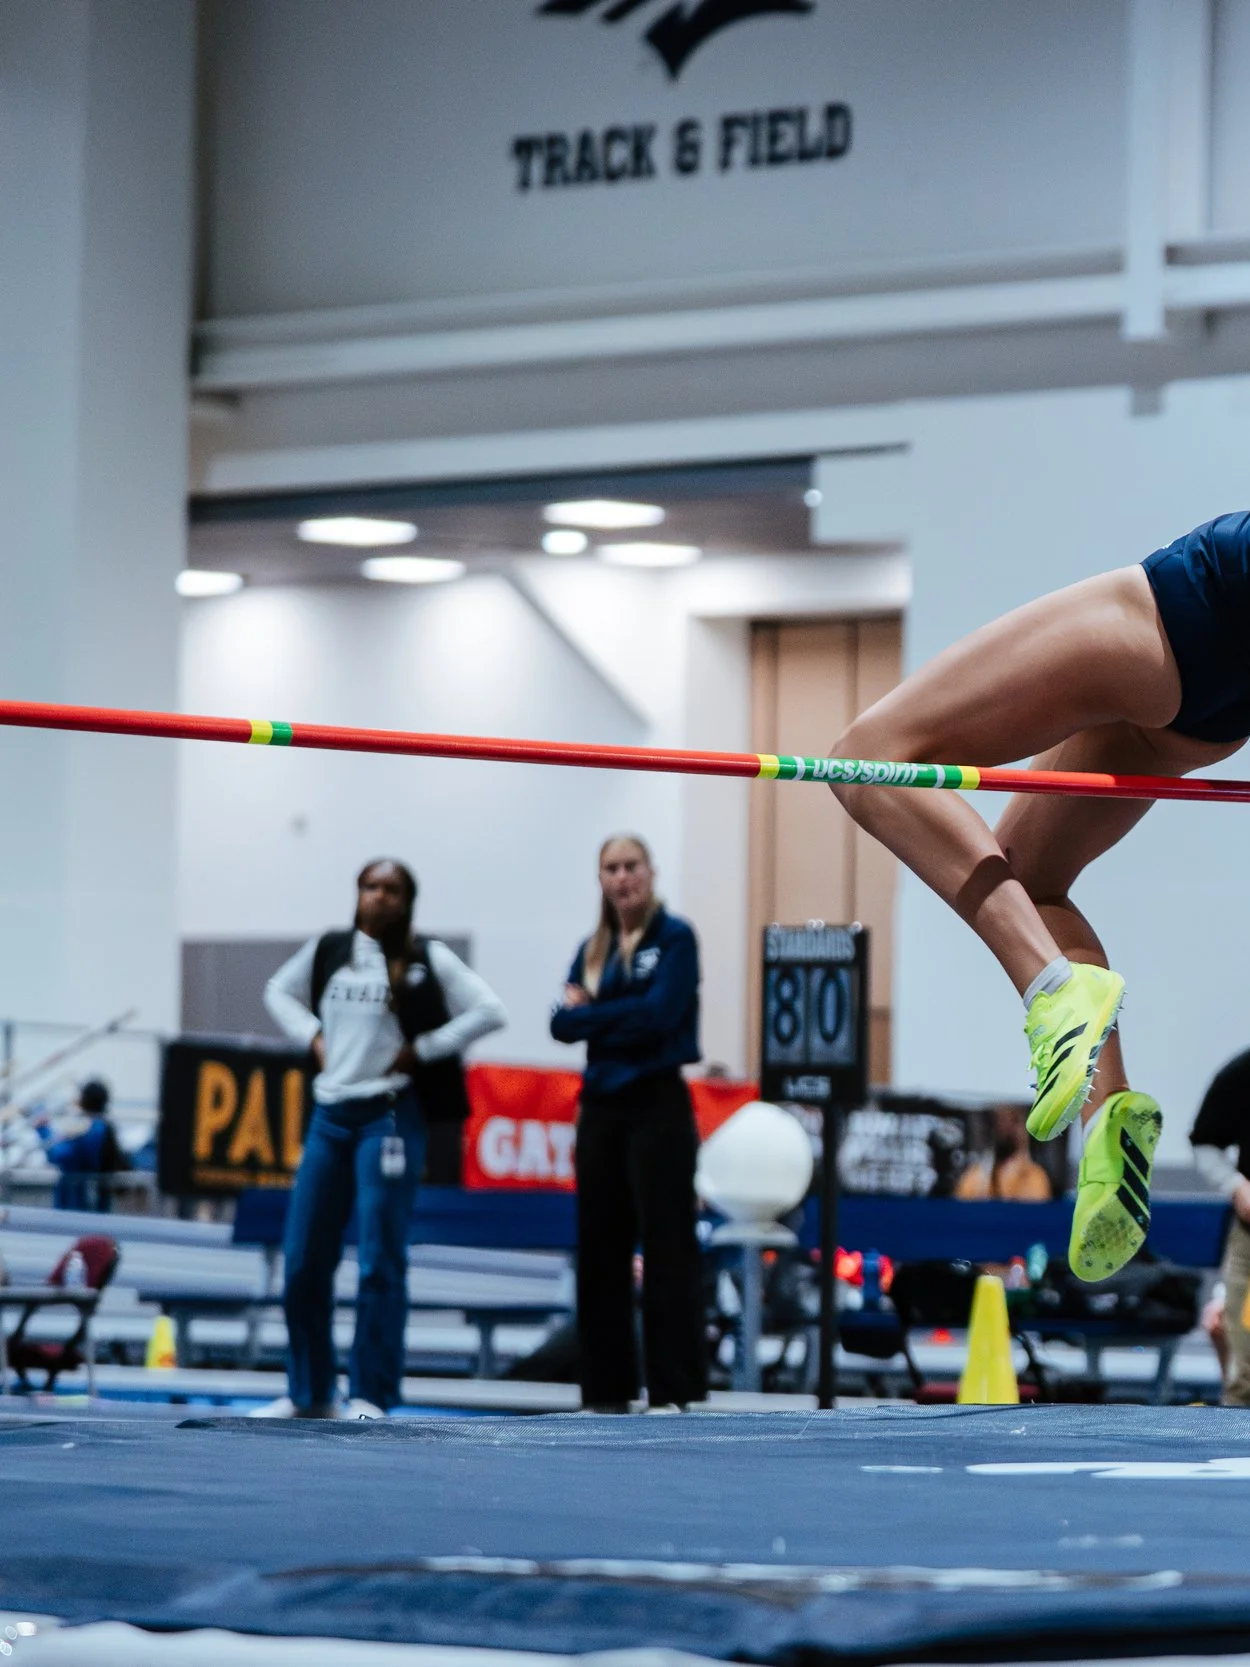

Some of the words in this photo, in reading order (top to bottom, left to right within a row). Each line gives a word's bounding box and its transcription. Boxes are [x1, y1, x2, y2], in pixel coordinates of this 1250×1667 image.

[512, 123, 658, 192] TRACK
[673, 117, 701, 174] &
[719, 101, 854, 174] FIELD
[773, 970, 847, 1046] 80
